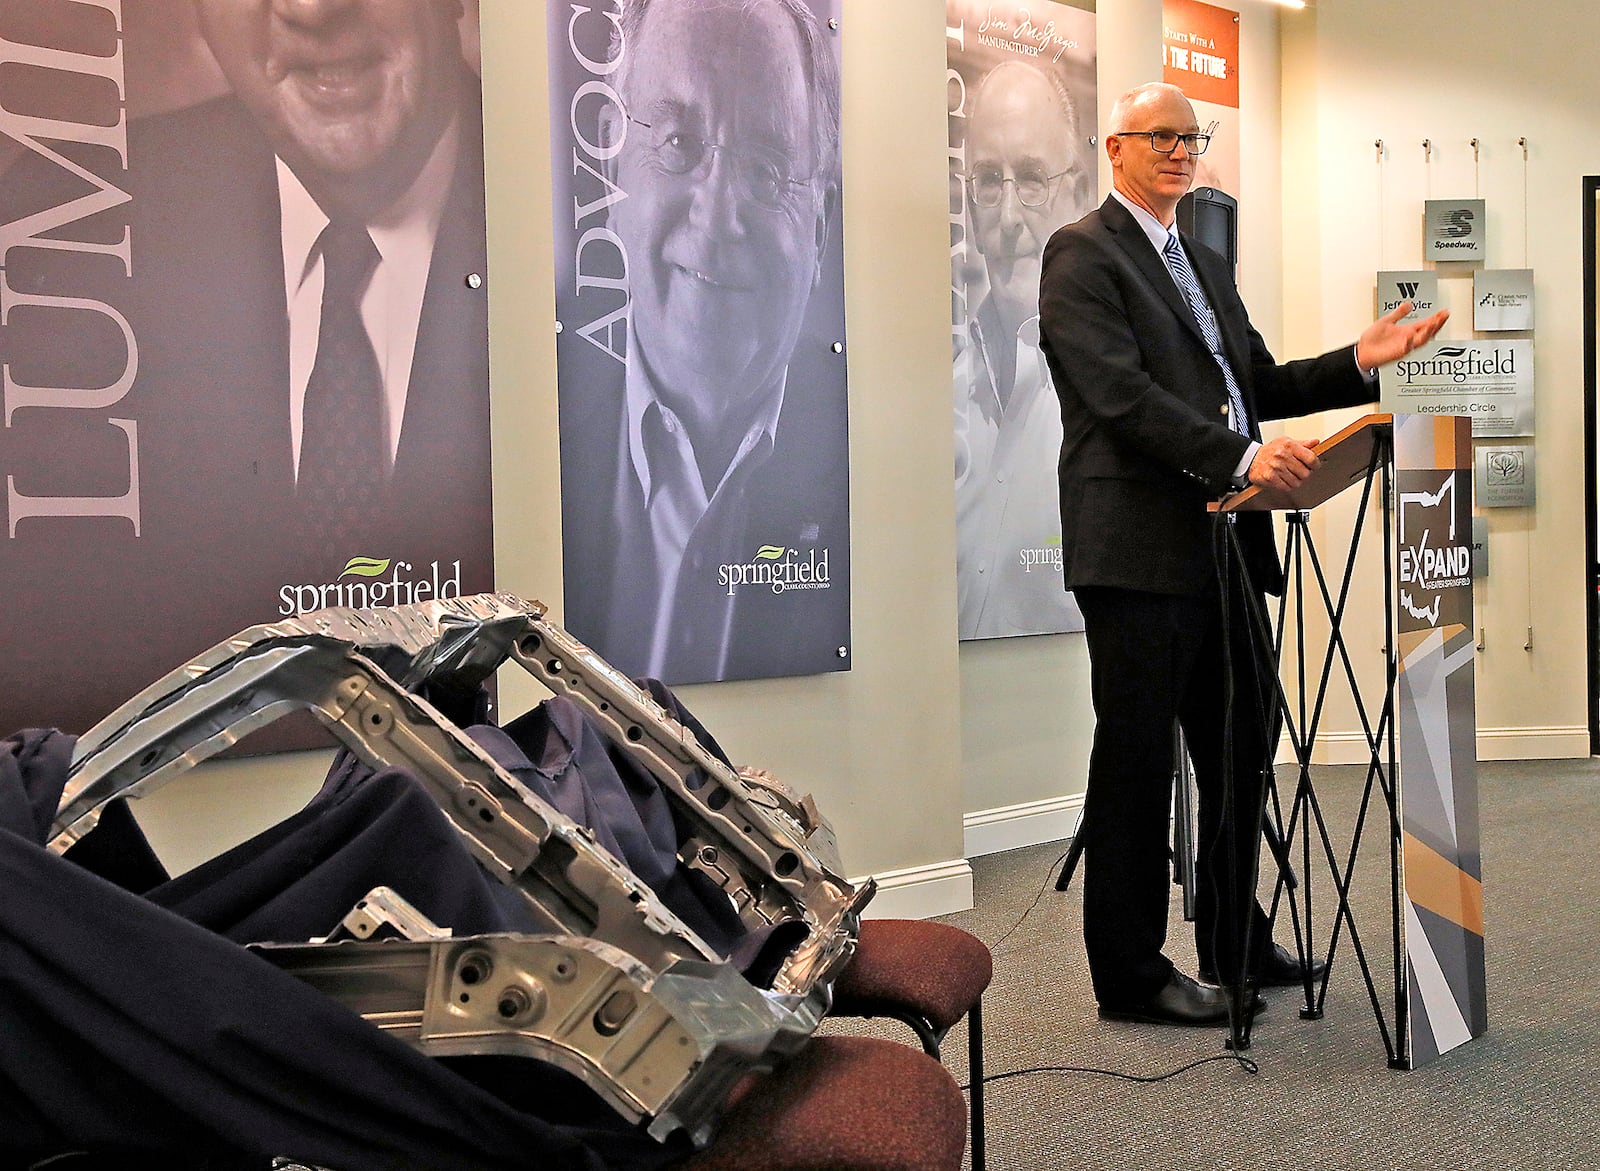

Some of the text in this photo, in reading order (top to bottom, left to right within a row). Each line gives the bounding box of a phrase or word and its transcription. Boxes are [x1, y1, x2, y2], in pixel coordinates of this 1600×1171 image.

[978, 34, 1039, 58] MANUFACTURER
[1209, 38, 1215, 50] A
[1170, 46, 1189, 71] THE
[1191, 50, 1227, 80] FUTURE
[569, 0, 630, 367] ADVOC
[1434, 240, 1476, 250] Speedway
[0, 0, 141, 539] LUMI
[1411, 301, 1432, 312] yler
[1396, 348, 1516, 384] springfield
[1422, 386, 1452, 394] Springfield
[1417, 402, 1496, 413] Leadership Circle
[718, 548, 831, 596] springfield
[1400, 529, 1470, 589] EXPAND
